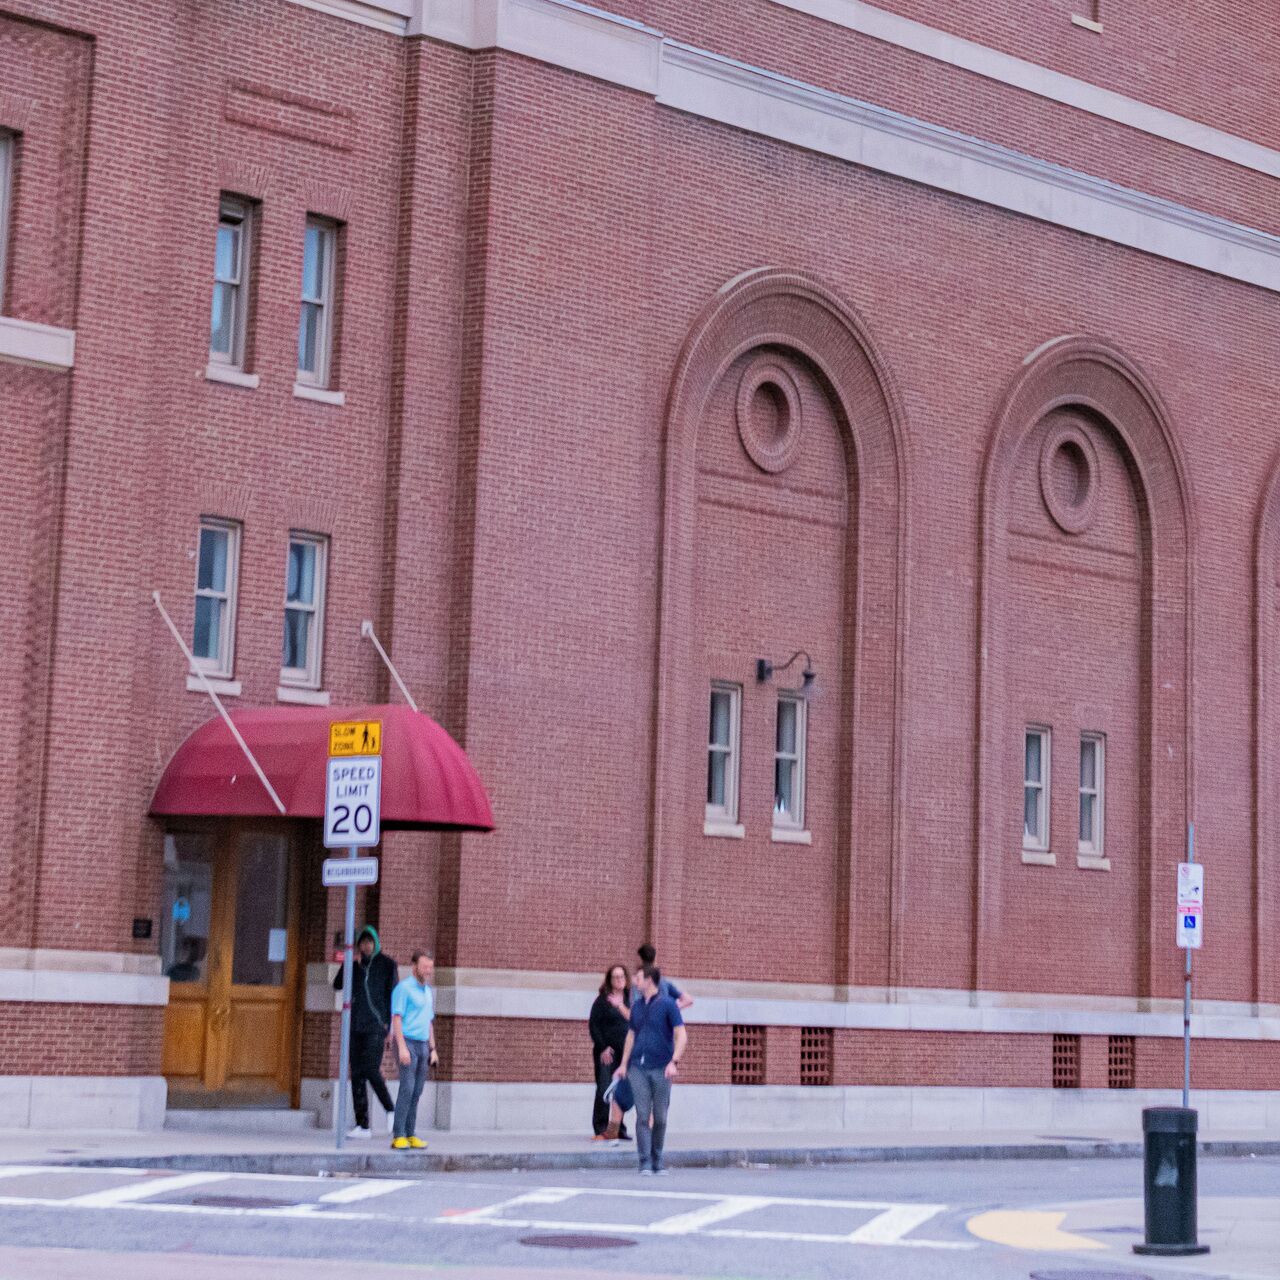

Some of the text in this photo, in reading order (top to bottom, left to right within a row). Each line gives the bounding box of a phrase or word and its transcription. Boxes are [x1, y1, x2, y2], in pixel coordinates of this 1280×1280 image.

[333, 767, 375, 781] SPEED
[336, 784, 369, 799] LIMIT
[332, 804, 372, 834] 20
